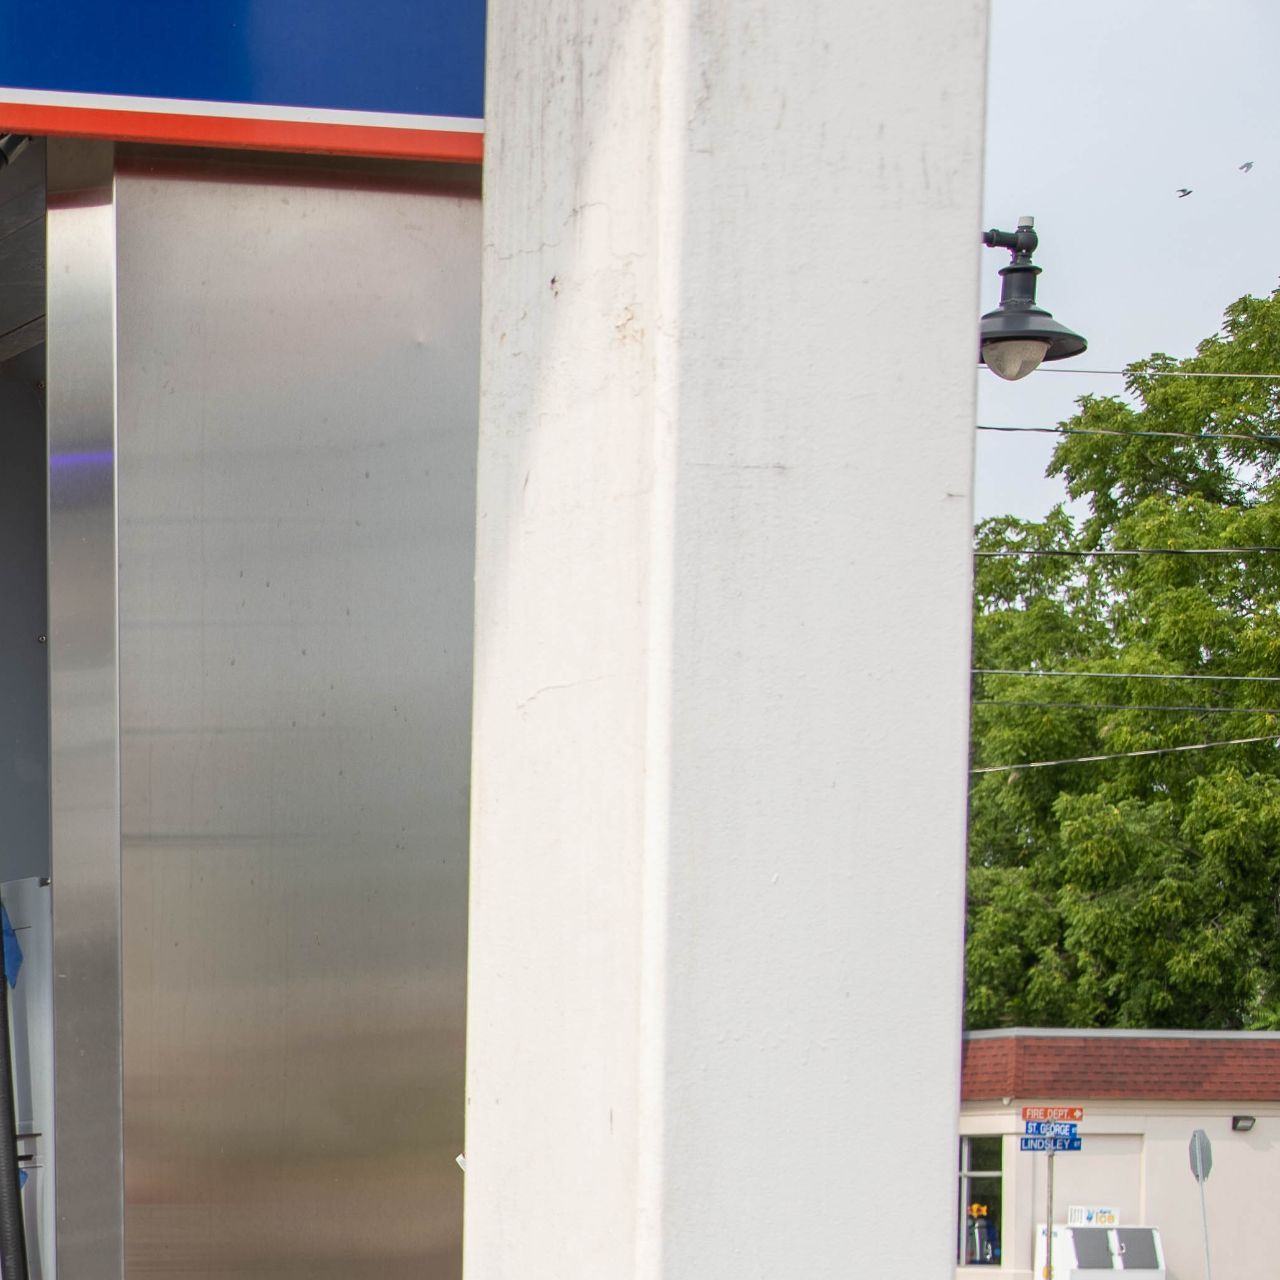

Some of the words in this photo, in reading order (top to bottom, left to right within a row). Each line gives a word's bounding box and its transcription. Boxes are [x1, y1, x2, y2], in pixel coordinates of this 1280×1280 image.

[1026, 1108, 1045, 1119] FIRE
[1047, 1108, 1071, 1120] DEPT.
[1027, 1122, 1039, 1135] ST.
[1040, 1123, 1071, 1136] GEORGE
[1021, 1138, 1071, 1151] LINDSLEY
